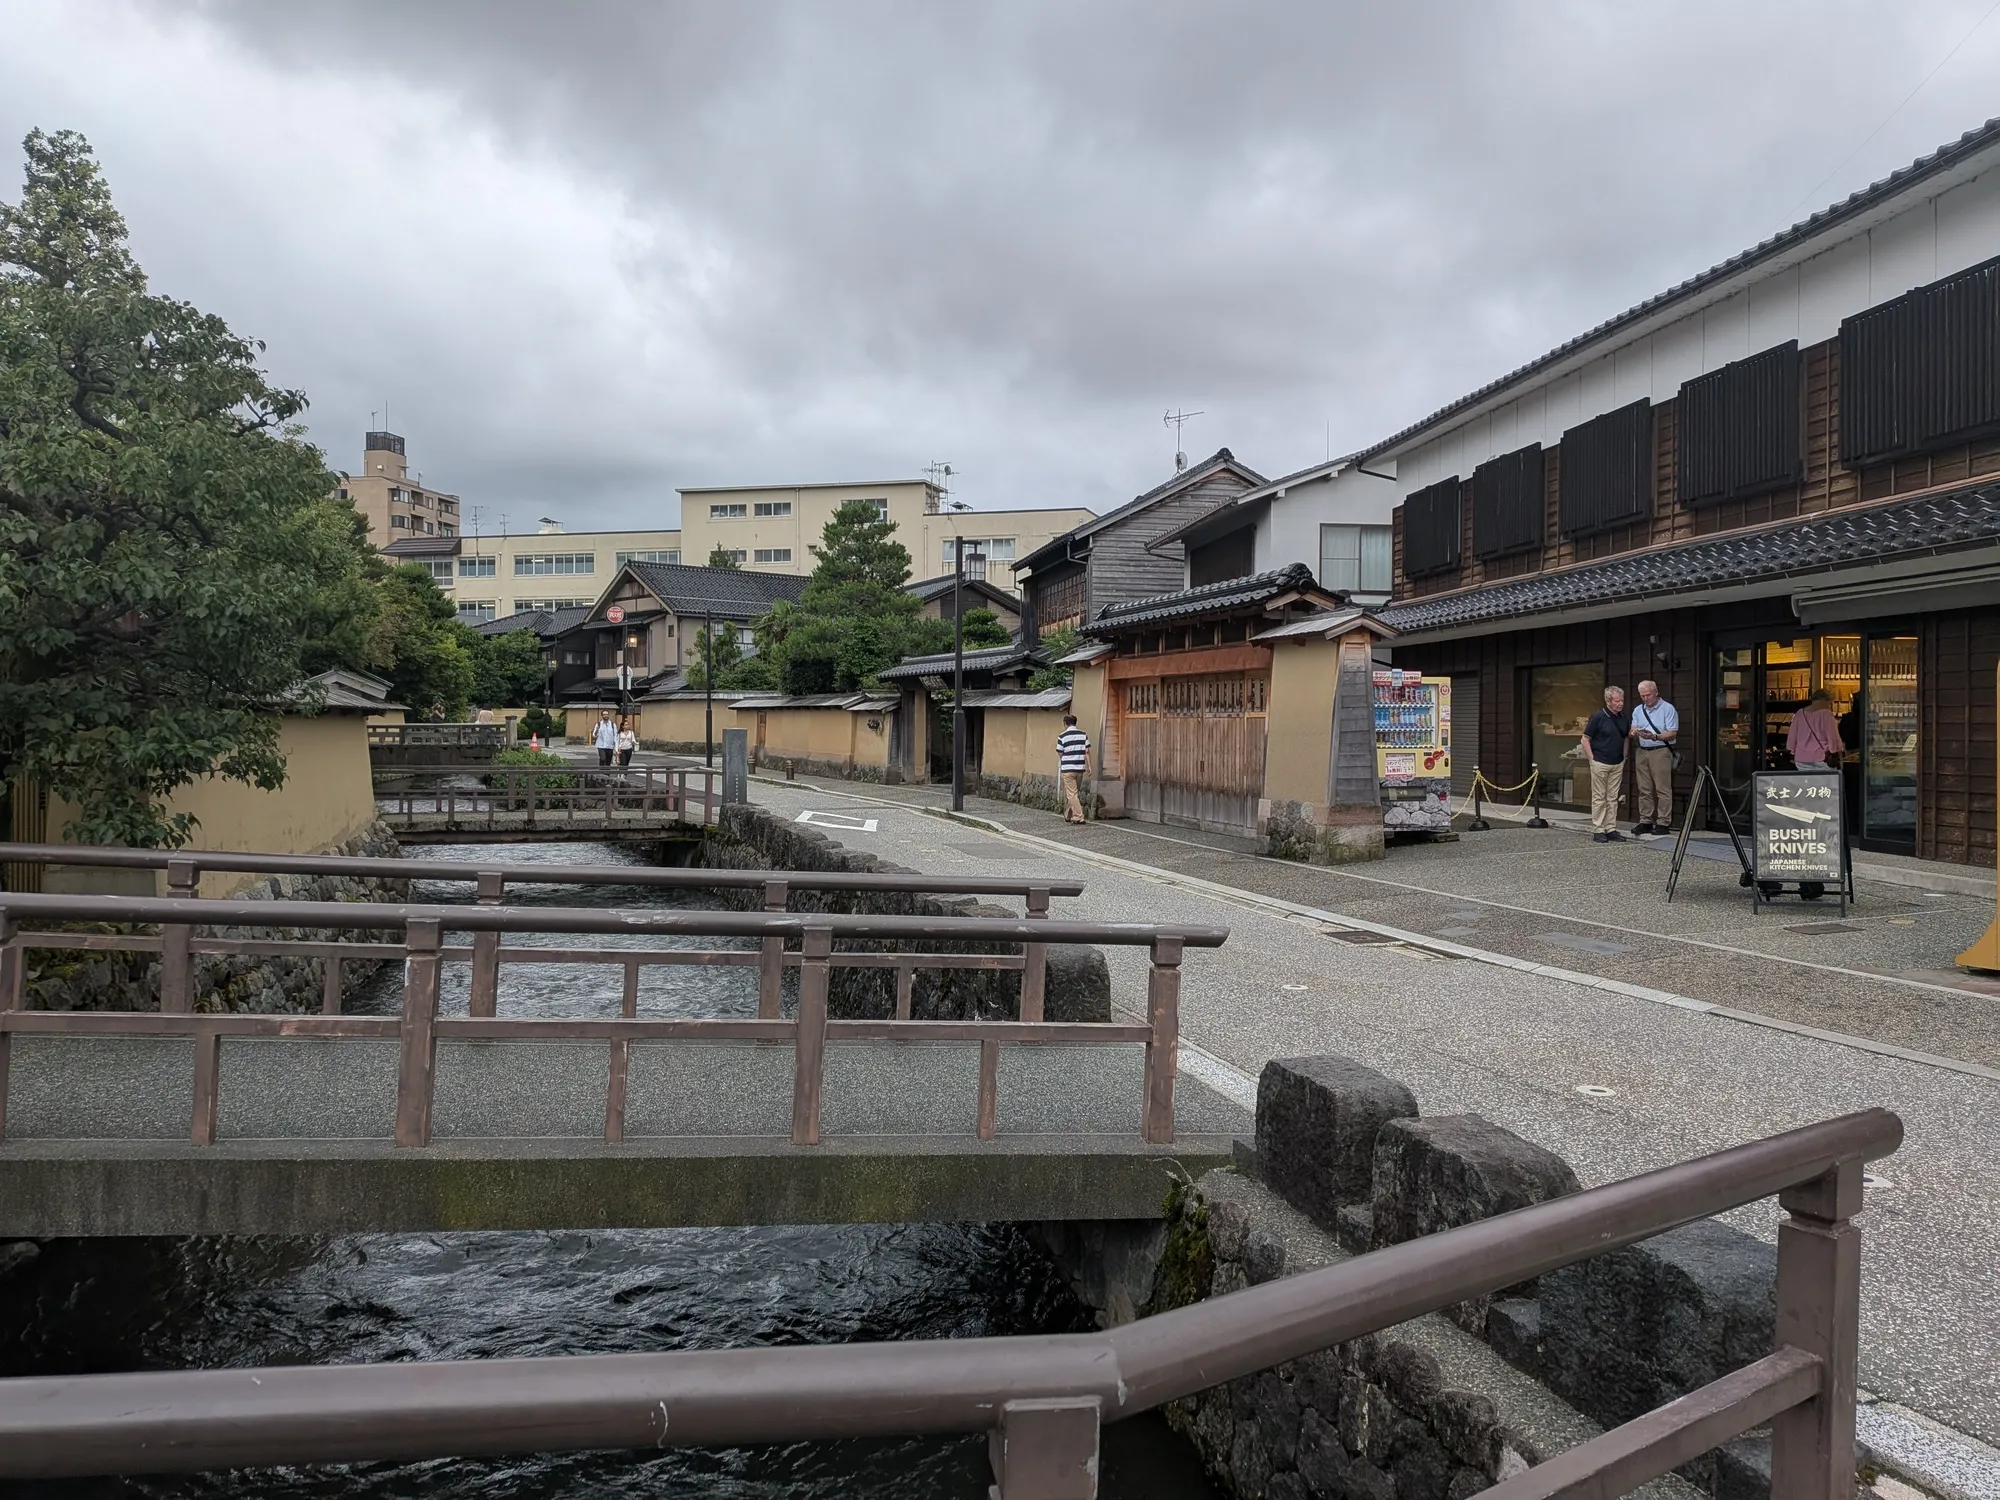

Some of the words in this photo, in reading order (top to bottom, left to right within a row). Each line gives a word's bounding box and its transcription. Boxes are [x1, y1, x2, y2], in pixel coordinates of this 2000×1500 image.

[1766, 786, 1832, 799] 武士ノ刃物
[1769, 829, 1816, 840] BUSHI
[1769, 843, 1827, 854] KNIVES
